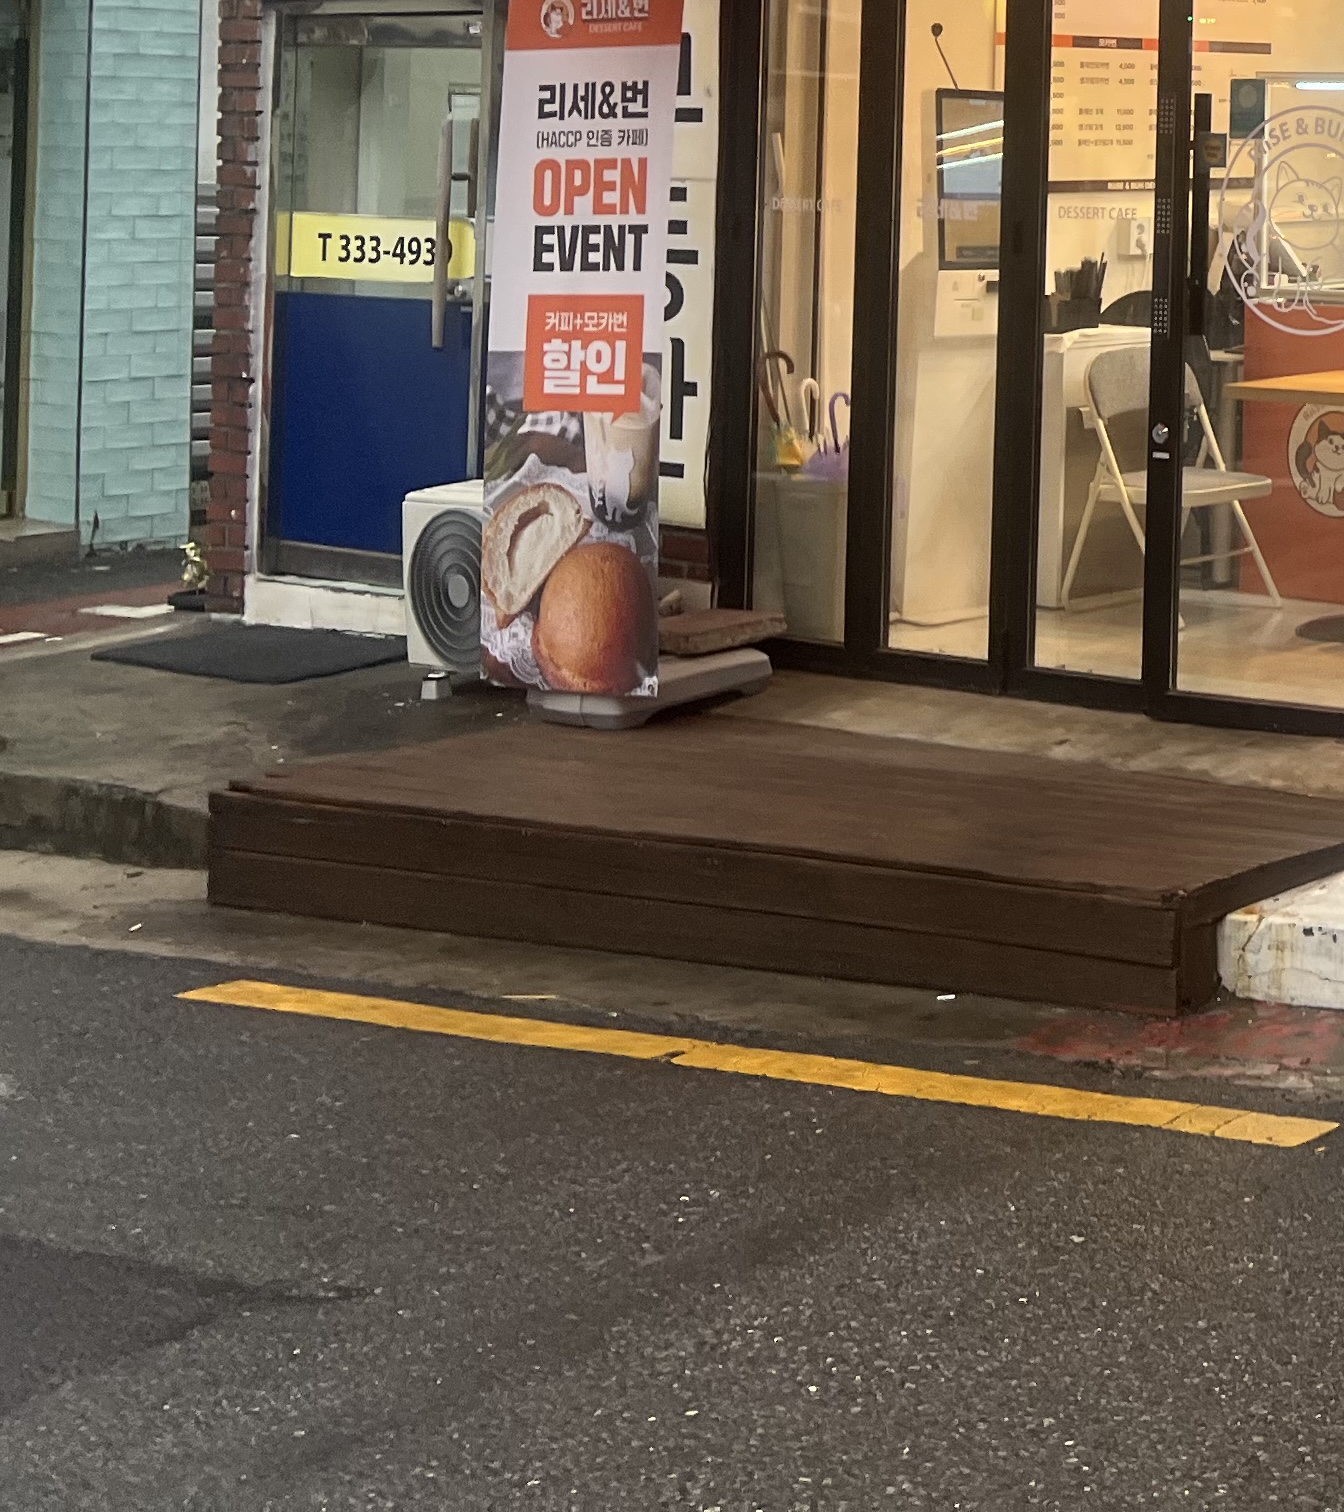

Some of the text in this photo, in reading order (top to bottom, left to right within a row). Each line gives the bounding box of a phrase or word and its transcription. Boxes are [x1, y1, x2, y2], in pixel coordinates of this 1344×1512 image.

[537, 80, 649, 121] 리세&번
[536, 130, 582, 149] (HACCP
[586, 129, 613, 147] 인증
[533, 157, 648, 216] OPEN
[1057, 205, 1138, 221] DESSERT CAFE
[318, 232, 453, 266] T 333-493
[533, 224, 649, 272] EVENT
[545, 311, 628, 333] 커피+모카번
[542, 338, 627, 395] 할인
